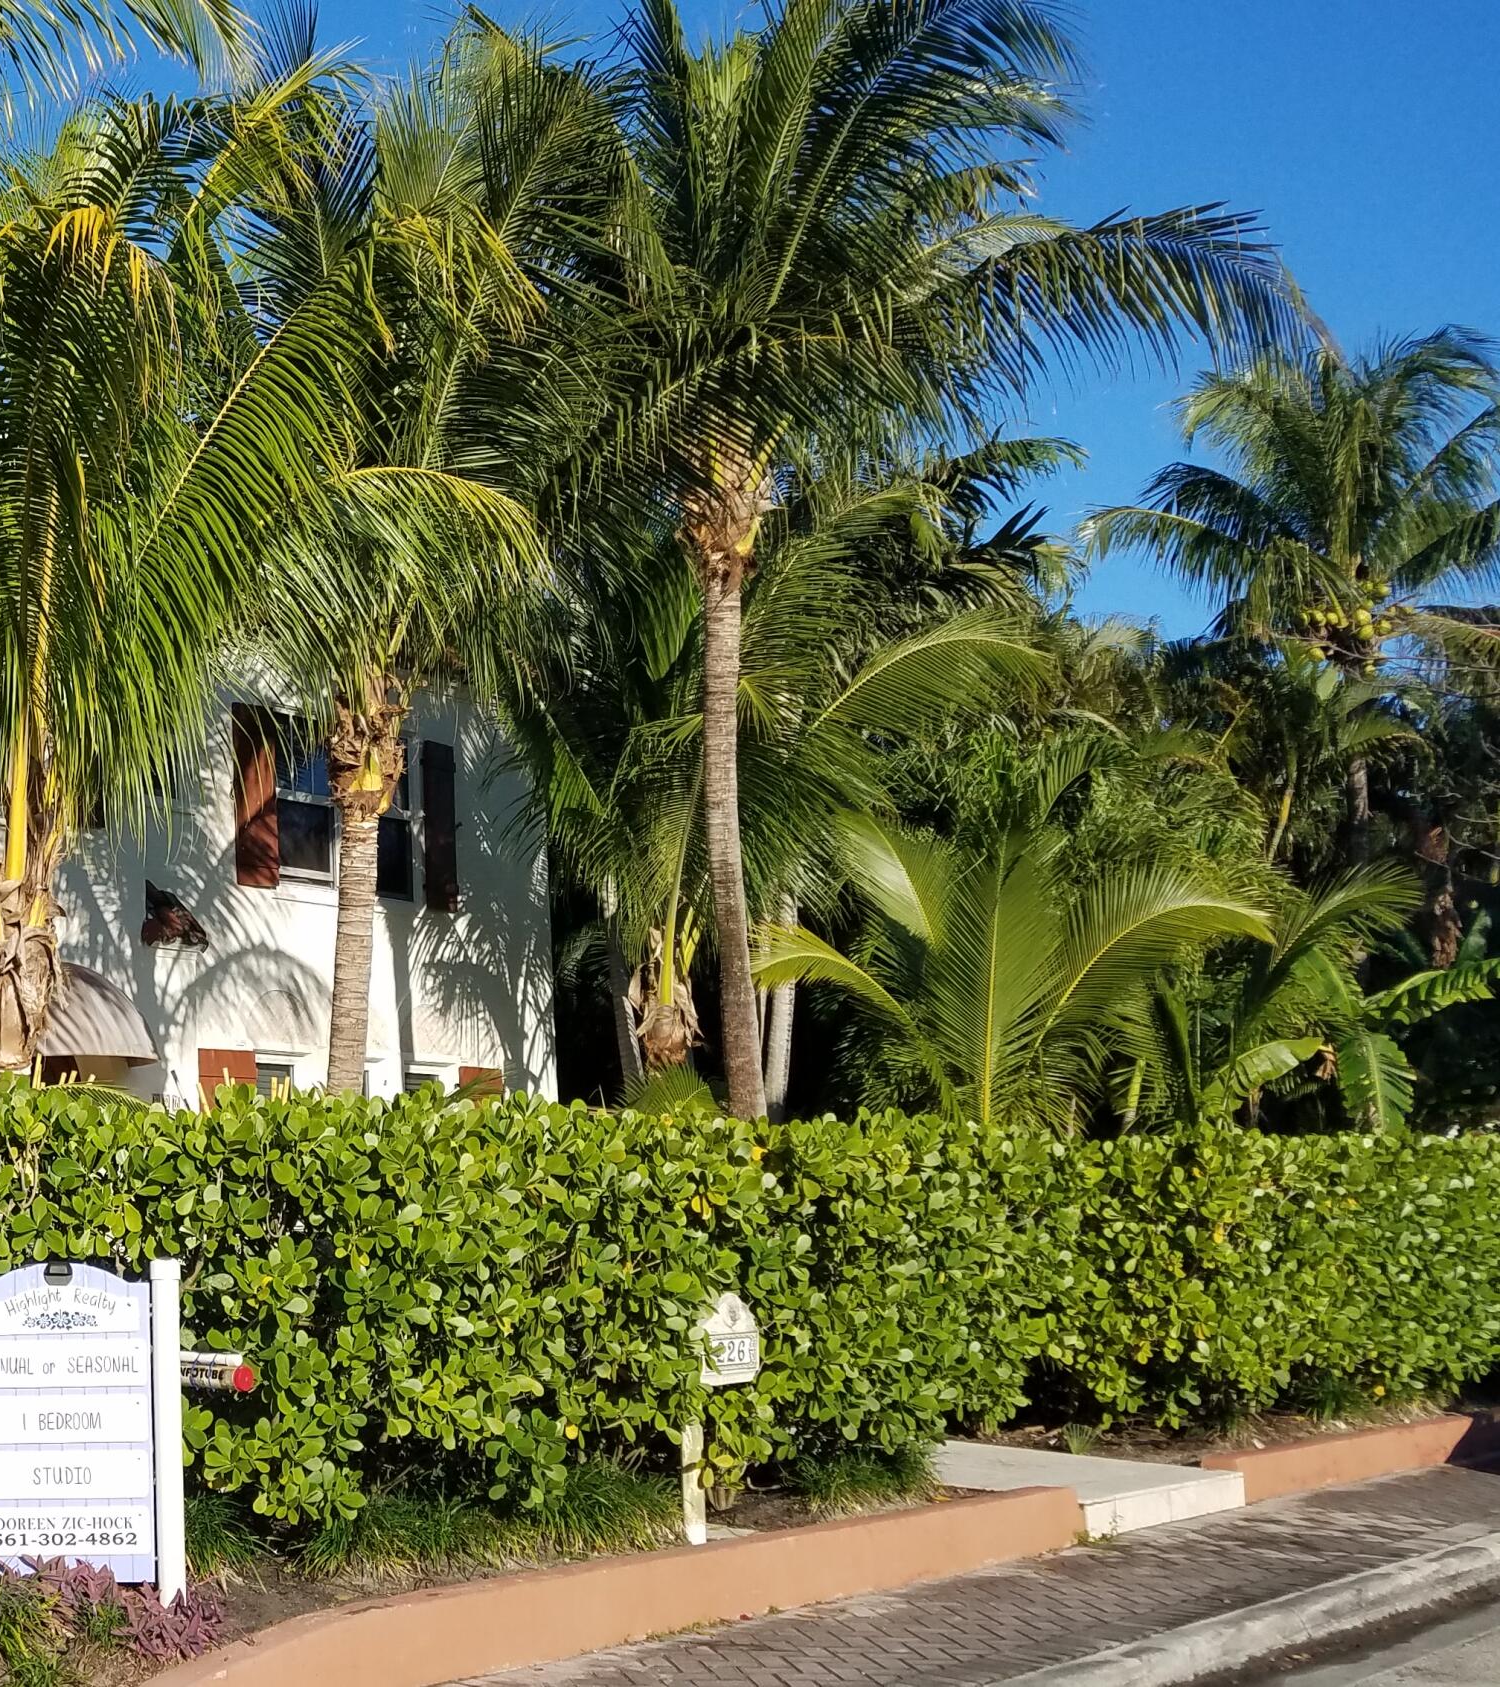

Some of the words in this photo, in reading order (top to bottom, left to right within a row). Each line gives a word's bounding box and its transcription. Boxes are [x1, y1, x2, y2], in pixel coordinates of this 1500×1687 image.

[4, 1288, 61, 1316] Highlight
[74, 1288, 116, 1315] Realty
[42, 1362, 55, 1374] or
[67, 1356, 138, 1374] SEASONAL
[181, 1367, 225, 1380] NFOTUBE
[39, 1412, 102, 1430] BEDROOM
[33, 1466, 92, 1485] STUDIO
[62, 1517, 133, 1530] ZIC-HOCK
